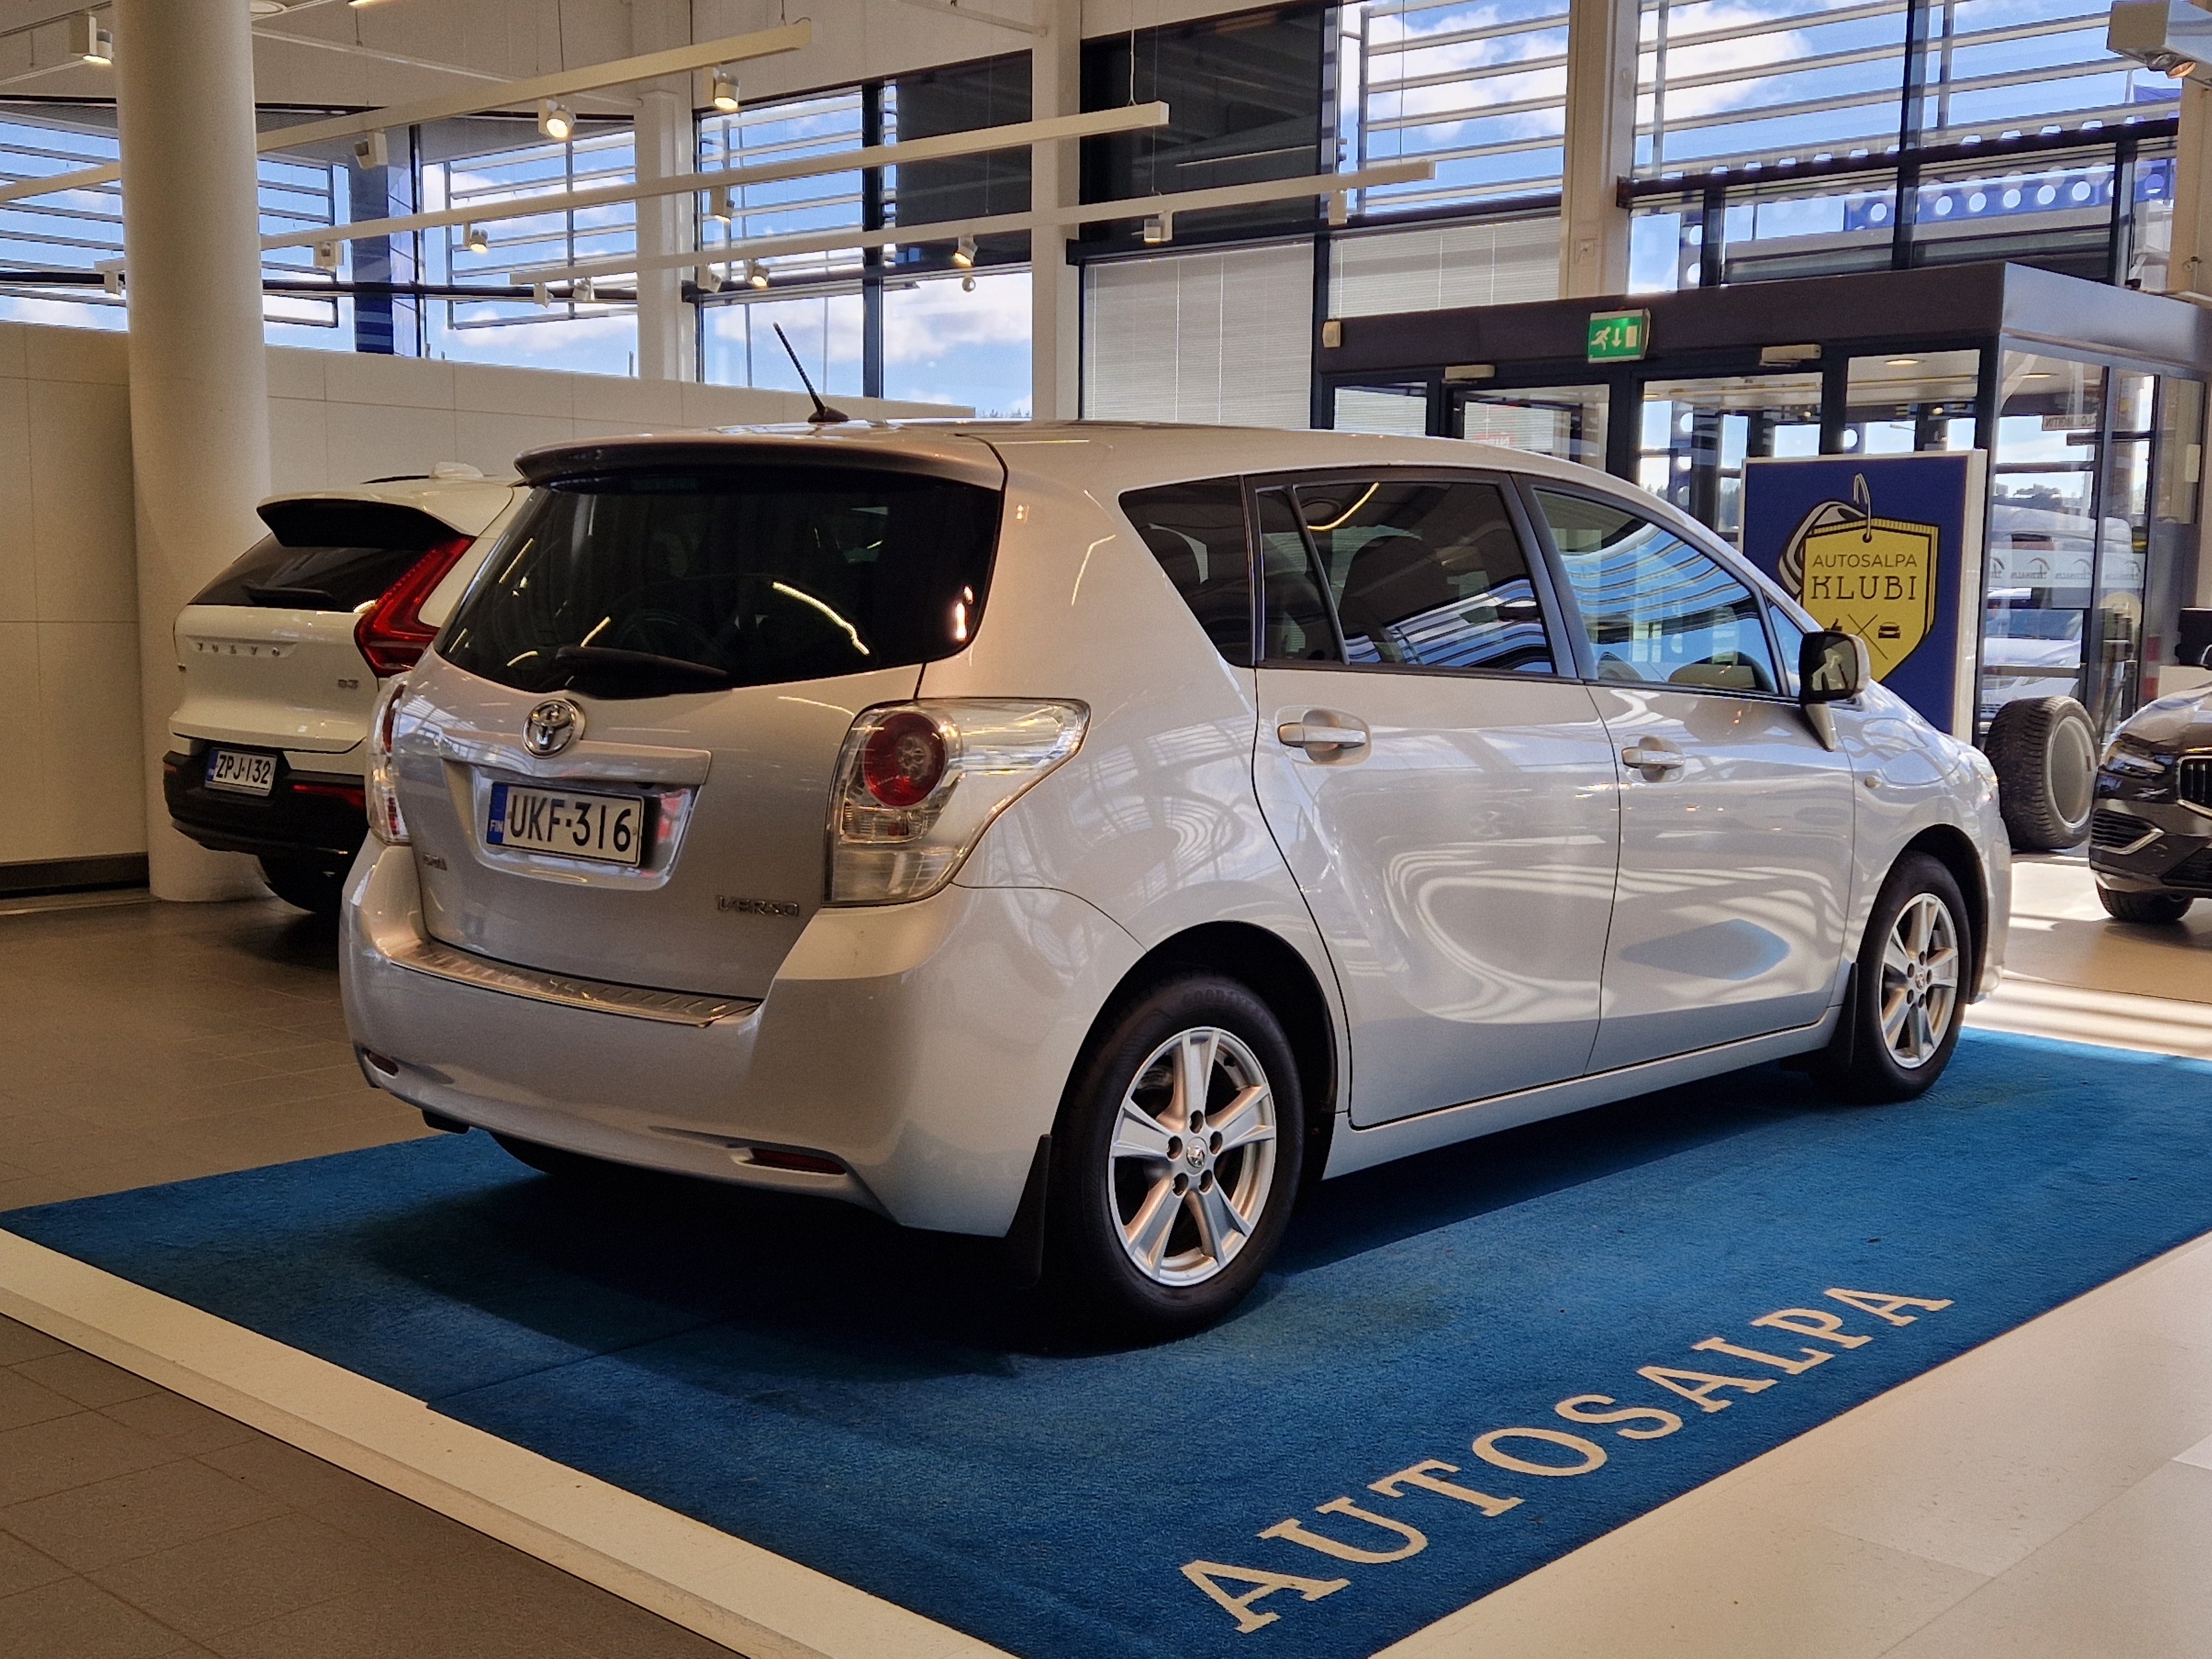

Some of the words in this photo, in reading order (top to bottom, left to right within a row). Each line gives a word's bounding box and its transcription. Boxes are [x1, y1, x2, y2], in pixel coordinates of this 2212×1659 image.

[1812, 554, 1918, 568] AUTOSALPA
[1811, 576, 1917, 600] KLUBI
[216, 754, 271, 784] ZPJ-132
[510, 795, 632, 852] UKF-316
[715, 894, 800, 917] VERSO
[1181, 1287, 1955, 1634] AUTOSALPA
